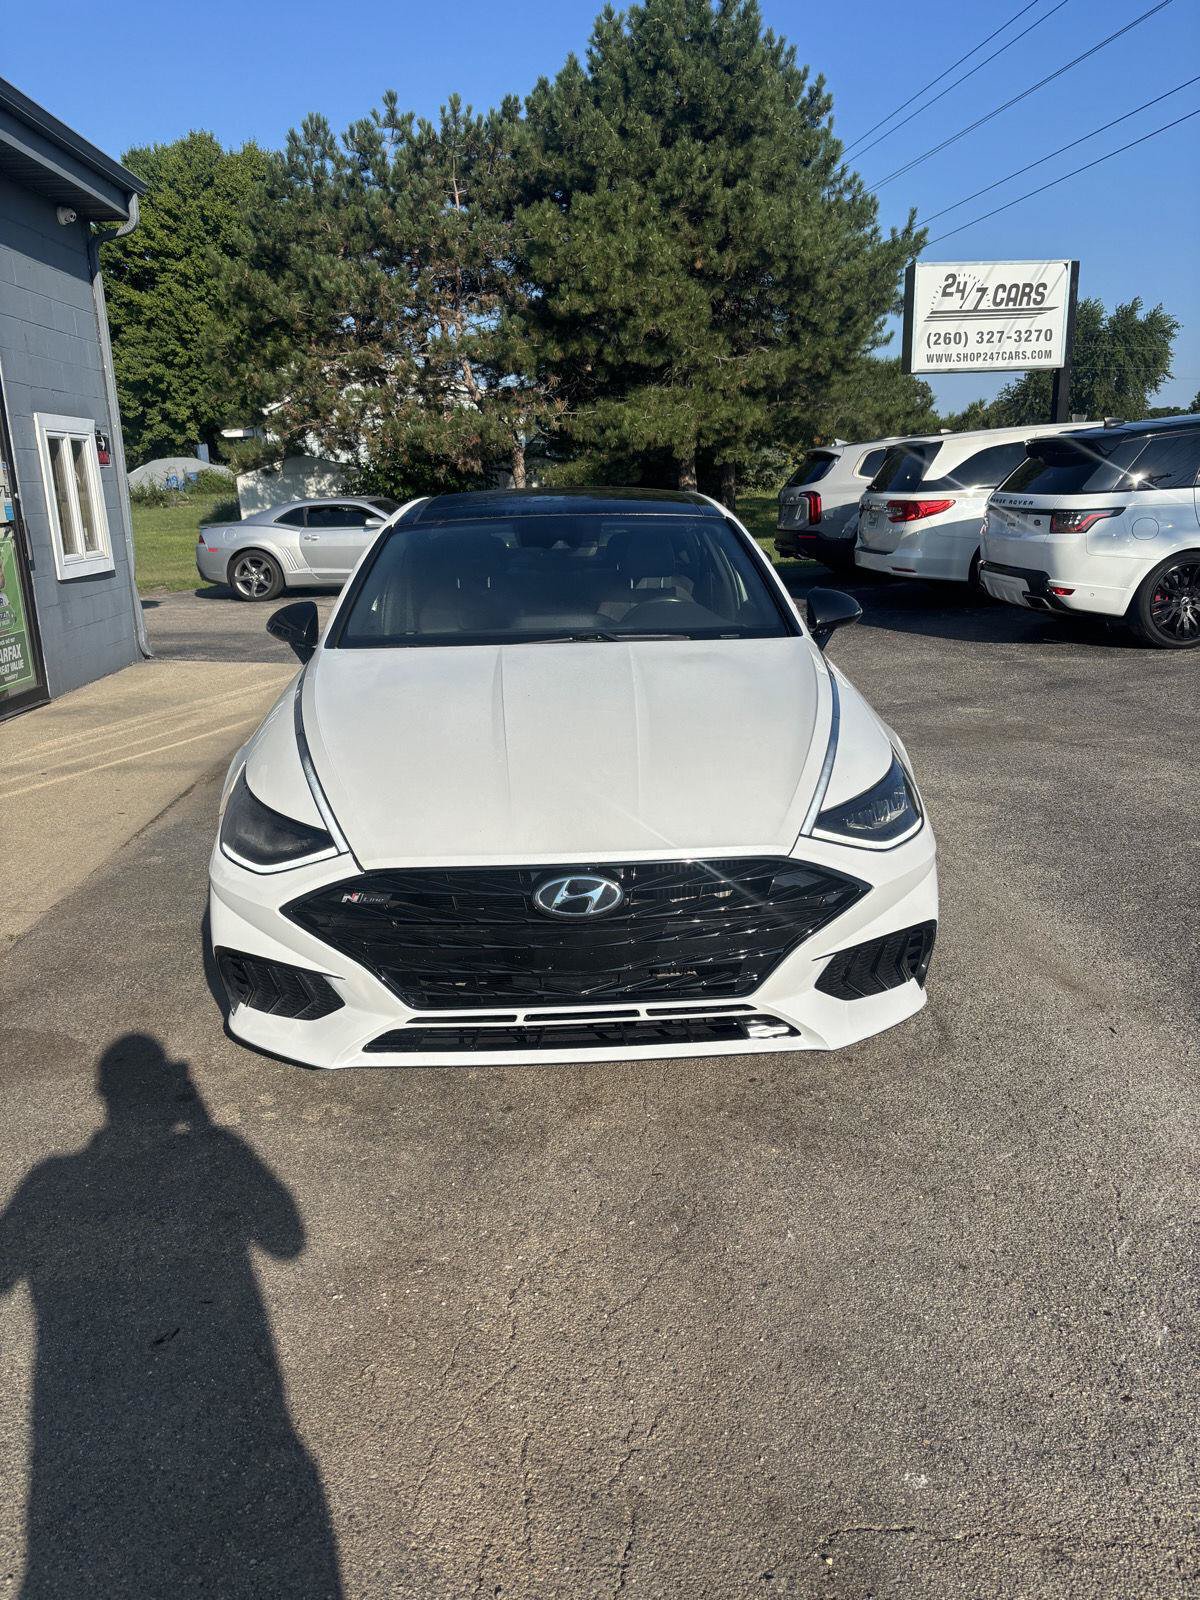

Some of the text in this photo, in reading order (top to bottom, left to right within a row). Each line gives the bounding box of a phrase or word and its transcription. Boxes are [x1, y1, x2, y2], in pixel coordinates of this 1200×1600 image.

[992, 282, 1048, 307] CARS
[926, 329, 1053, 348] (260) 327-3270
[926, 350, 1052, 363] WWW.SHOP247CARS.COM
